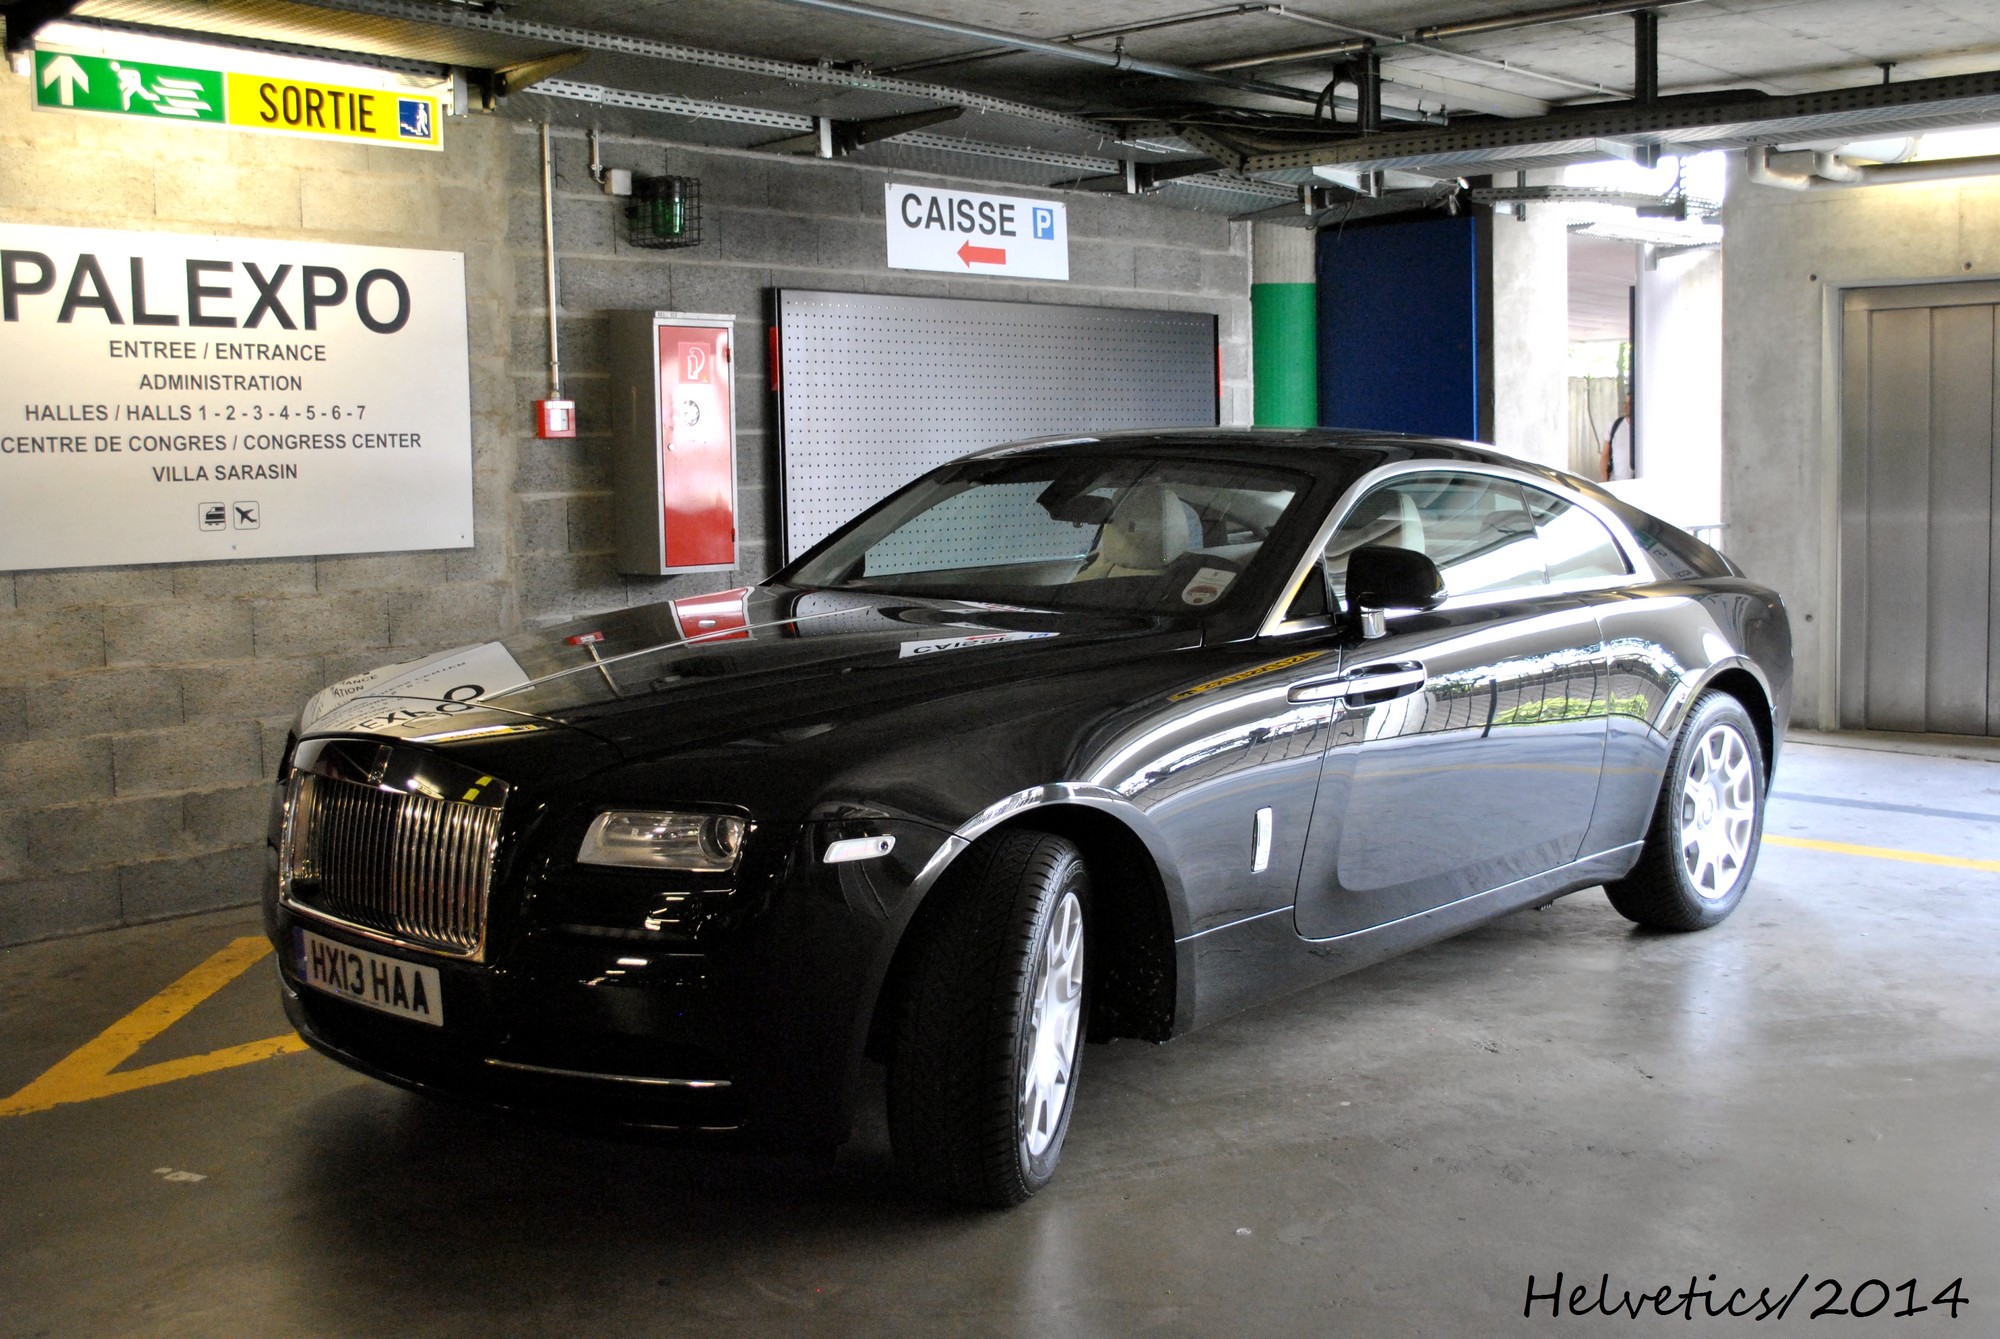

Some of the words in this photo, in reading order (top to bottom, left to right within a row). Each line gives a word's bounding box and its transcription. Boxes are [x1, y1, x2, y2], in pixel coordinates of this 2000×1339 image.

[259, 82, 377, 134] SORTIE
[901, 193, 1017, 237] CAISSE
[1036, 209, 1052, 238] P
[0, 249, 411, 335] PALEXPO
[109, 340, 196, 359] ENTREE
[215, 343, 327, 362] ENTRANCE
[139, 374, 303, 392] ADMINISTRATION
[25, 404, 108, 422] HALLES
[126, 404, 192, 421] HALLS
[1, 436, 88, 454] CENTRE
[94, 435, 122, 452] DE
[128, 435, 227, 452] CONGRES
[243, 433, 346, 451] CONGRESS
[352, 432, 422, 449] CENTER
[152, 465, 209, 482] VILLA
[215, 464, 298, 481] SARASIN
[310, 939, 366, 996] HX13
[371, 959, 430, 1015] HAA
